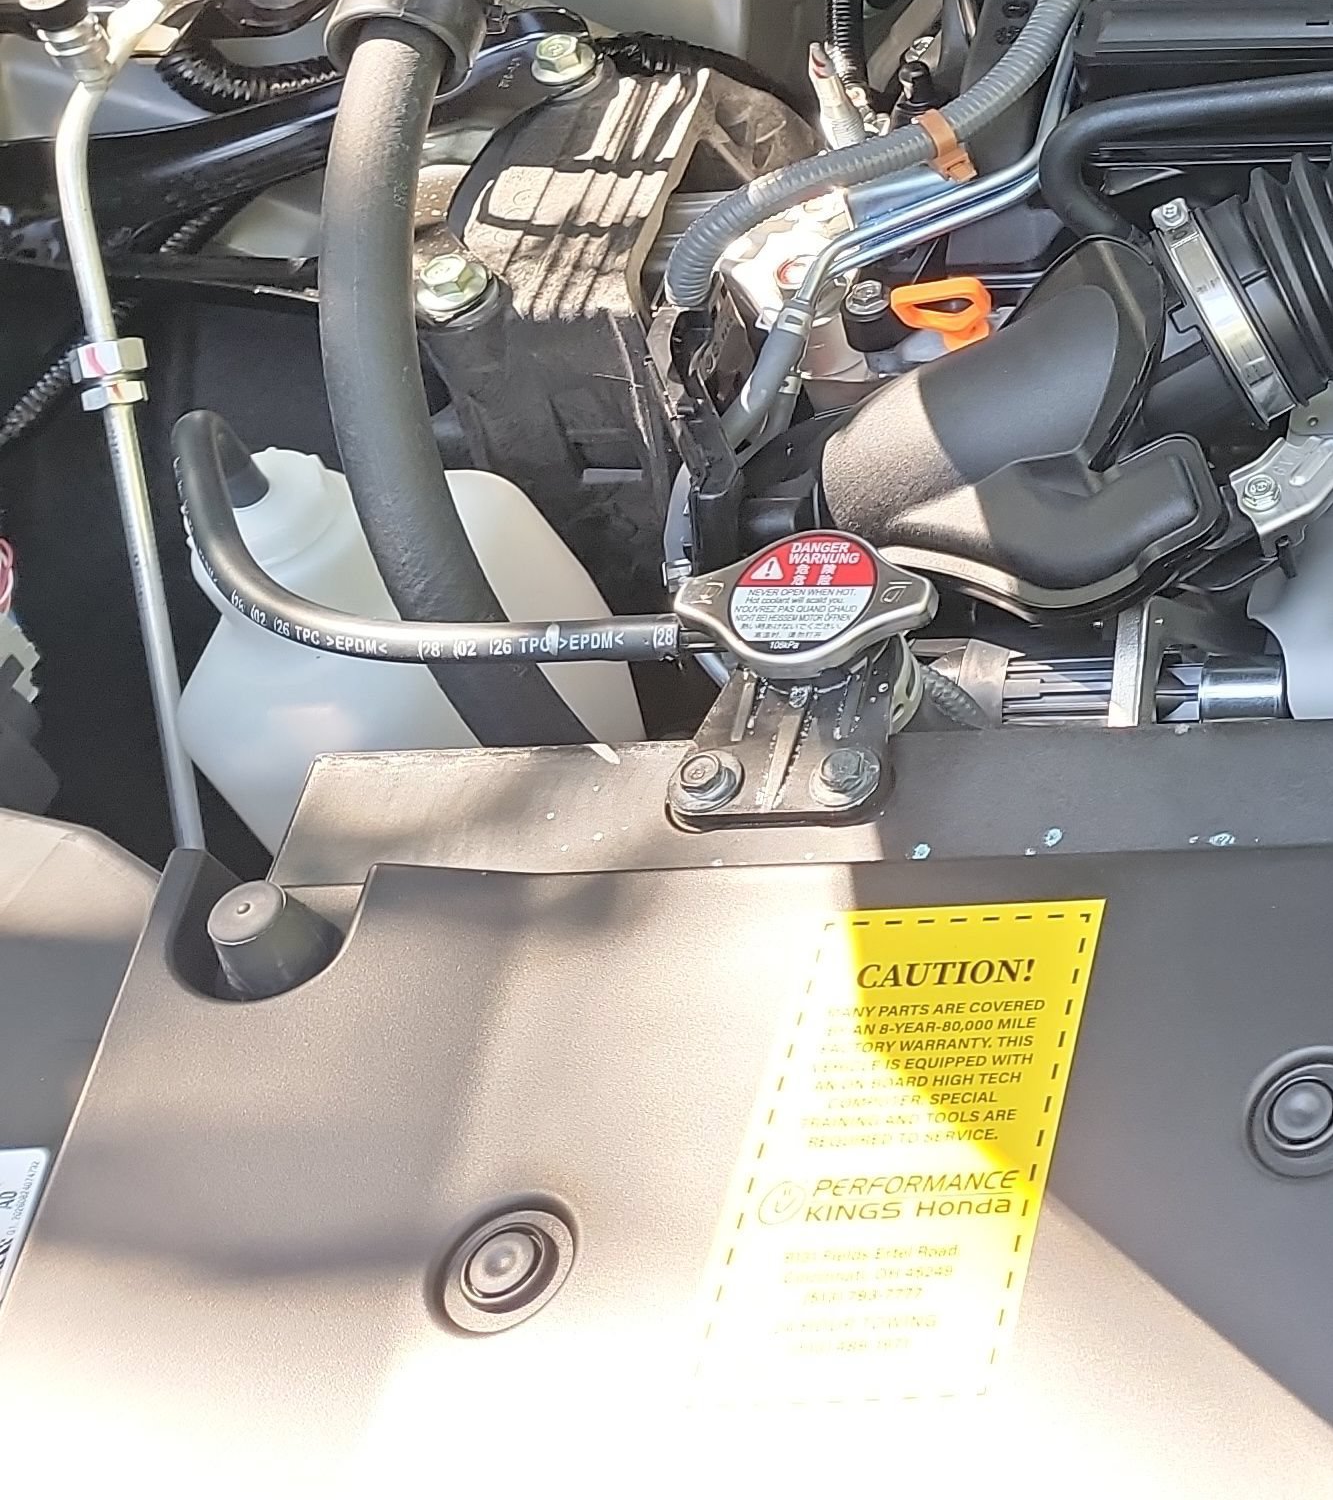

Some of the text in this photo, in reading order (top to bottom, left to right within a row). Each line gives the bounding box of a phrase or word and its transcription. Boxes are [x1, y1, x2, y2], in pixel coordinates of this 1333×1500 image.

[790, 541, 851, 553] DANGER
[788, 552, 861, 564] WARNUNG
[748, 588, 779, 596] NEVER
[780, 588, 807, 596] OPEN
[807, 588, 834, 596] WHEN
[778, 605, 795, 613] PAS
[796, 605, 826, 613] QUAND
[827, 605, 858, 613] CHAUD
[294, 625, 321, 646] TPC
[326, 634, 388, 655] >EPDM<
[559, 631, 624, 651] >EPDM<
[857, 958, 1036, 989] CAUTION!
[878, 1004, 929, 1018] PARTS
[932, 1002, 967, 1016] ARE
[968, 999, 1046, 1014] COVERED
[879, 1019, 994, 1036] 8-YEAR-80,000
[996, 1017, 1037, 1031] MILE
[899, 1037, 993, 1052] WARRANTY.
[997, 1035, 1034, 1049] THIS
[885, 1058, 901, 1071] IS
[904, 1055, 987, 1071] EQUIPPED
[992, 1052, 1034, 1067] WITH
[932, 1073, 973, 1088] HIGH
[978, 1071, 1022, 1086] TECH
[929, 1090, 998, 1106] SPECIAL
[926, 1110, 980, 1125] TOOLS
[982, 1108, 1018, 1122] ARE
[813, 1170, 1021, 1198] PERFORMANCE
[804, 1197, 1012, 1223] KINGS Honda
